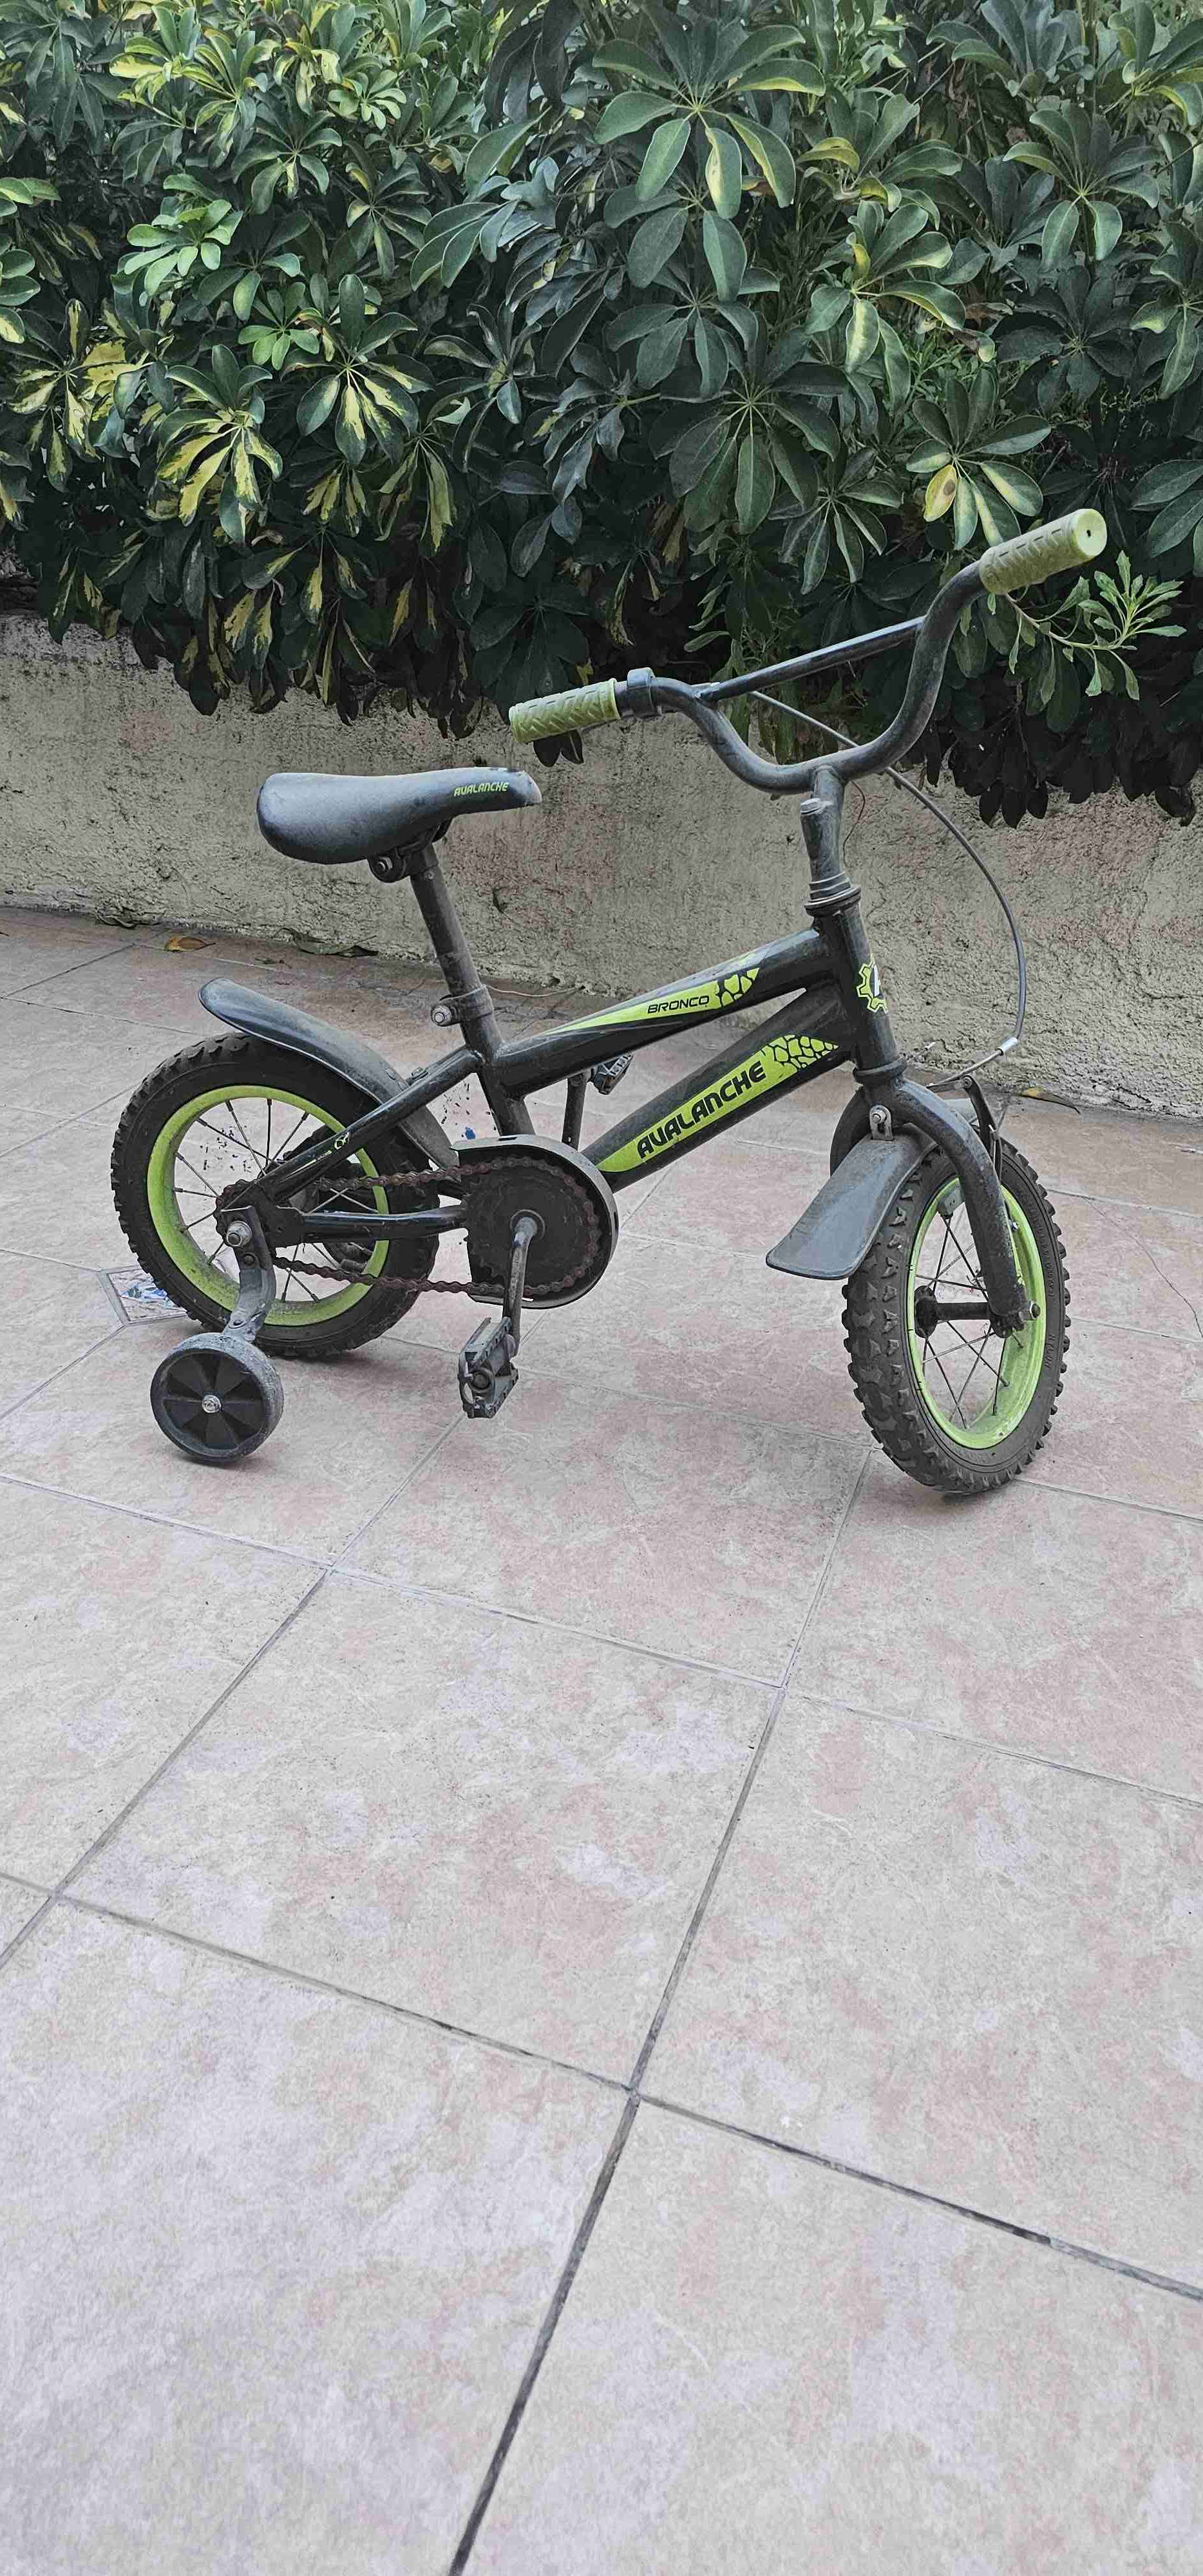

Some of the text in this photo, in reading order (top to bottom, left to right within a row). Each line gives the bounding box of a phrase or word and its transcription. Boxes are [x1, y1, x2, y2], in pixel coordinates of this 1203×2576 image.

[453, 781, 509, 796] AVALANCHE
[648, 995, 709, 1014] BRONCO
[638, 1061, 766, 1159] AVALANCHE
